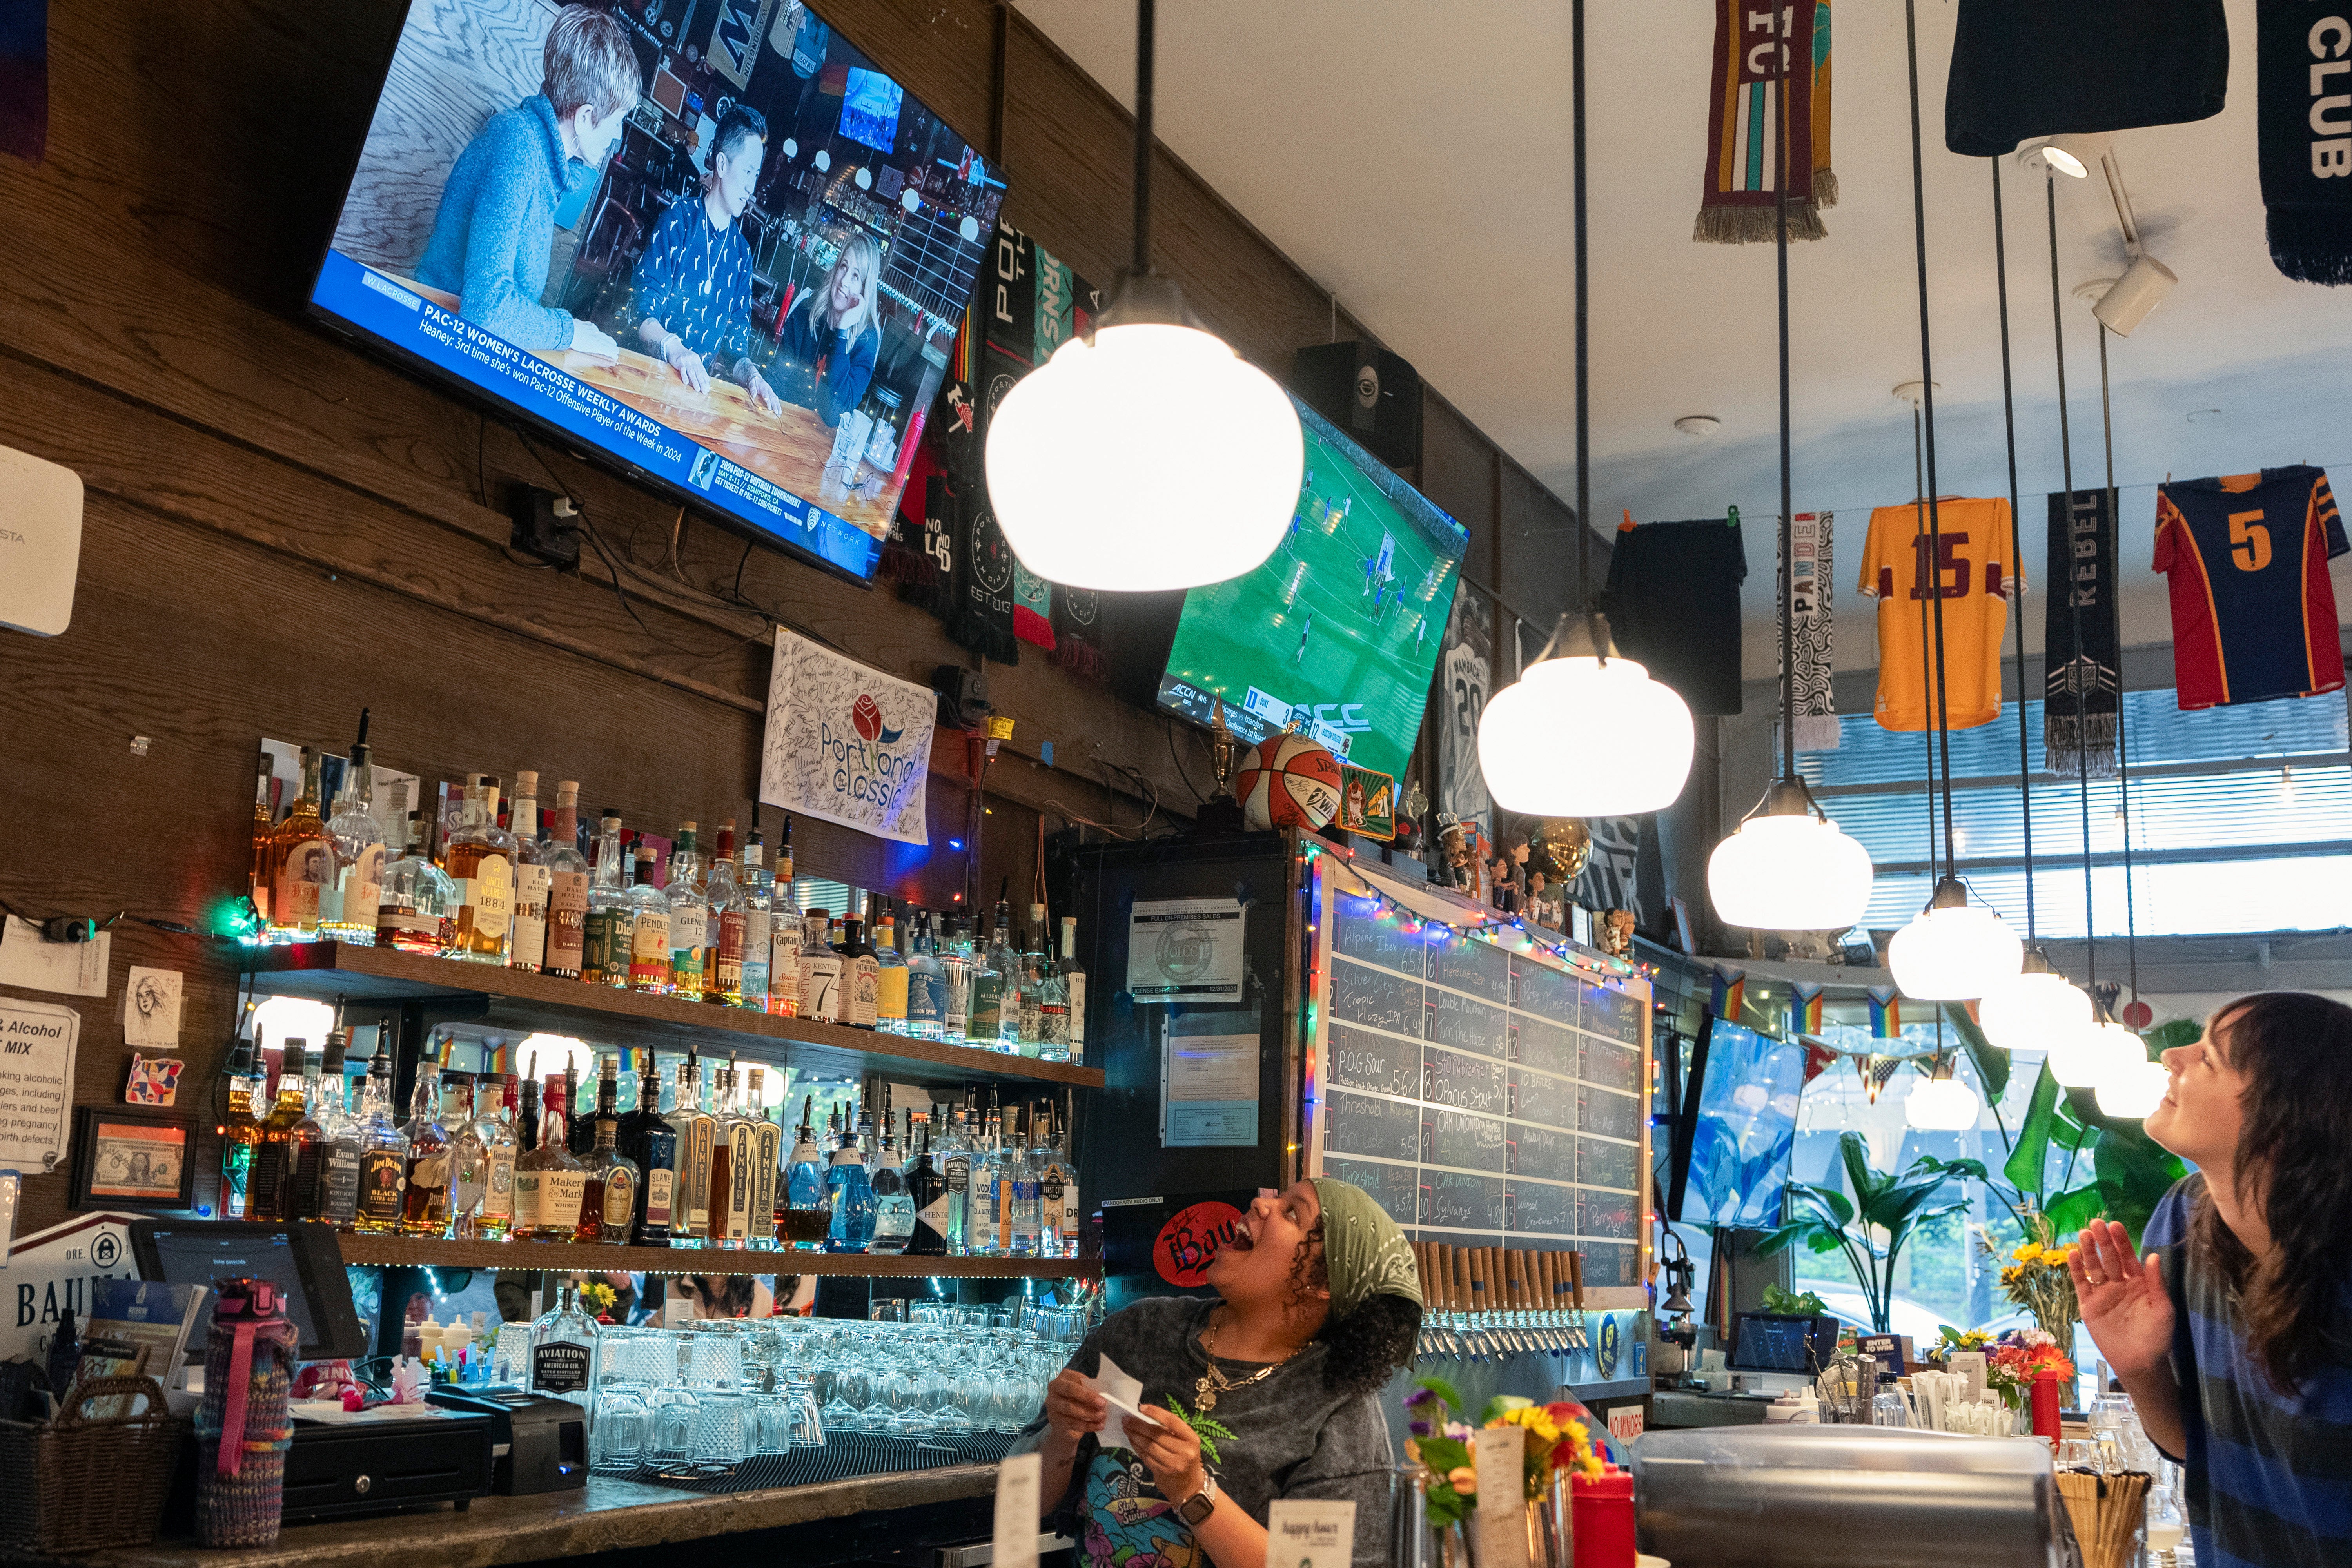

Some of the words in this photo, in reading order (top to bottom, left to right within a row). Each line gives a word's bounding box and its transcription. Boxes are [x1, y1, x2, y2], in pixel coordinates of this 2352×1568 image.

[744, 8, 768, 77] WASHINGTON
[2308, 16, 2352, 179] CLUB
[367, 276, 376, 285] W
[377, 281, 417, 307] LACROSSE
[424, 305, 465, 334] PAC-12
[467, 326, 519, 363] WOMEN'S
[521, 356, 576, 392] LACROSSE
[577, 384, 618, 414] WEEKLY
[618, 408, 661, 437] AWARDS
[419, 319, 454, 346] Heaney:
[455, 338, 471, 354] 3rd
[471, 347, 490, 364] time
[490, 357, 511, 375] she's
[512, 369, 529, 385] won
[530, 376, 555, 397] Pac-12
[556, 390, 590, 416] Offensive
[590, 407, 614, 428] Player
[614, 420, 624, 432] of
[623, 424, 635, 439] the
[636, 431, 656, 450] Week
[655, 441, 663, 454] in
[664, 446, 682, 463] 2024
[718, 469, 729, 480] MAY
[730, 475, 740, 486] 8-11
[747, 485, 771, 501] STANFORD,
[720, 460, 734, 474] 2024
[733, 466, 750, 482] PAC-12
[749, 474, 771, 493] SOFTBALL
[771, 485, 802, 508] TOURNAMENT
[715, 478, 724, 488] GET
[724, 481, 739, 495] TICKETS
[743, 491, 782, 516] PAC-12.COM/TICKETS
[821, 520, 860, 546] NETWORK
[2229, 509, 2271, 571] 5
[1910, 532, 1970, 600] 15
[1453, 657, 1479, 680] WAMBACH
[1172, 683, 1196, 699] ACCN
[1198, 694, 1207, 704] NHL
[1260, 697, 1269, 708] DUKE
[1283, 708, 1289, 725] 3
[1455, 679, 1481, 737] 20
[1226, 719, 1247, 735] Conference
[1254, 731, 1266, 742] Round
[1245, 715, 1264, 730] Islanders
[1312, 722, 1319, 739] 12
[1323, 729, 1332, 739] BOSTON
[1332, 733, 1342, 744] COLLEGE
[1378, 795, 1389, 817] 21
[481, 885, 507, 899] NEAREST
[486, 876, 504, 888] UNCLE
[480, 896, 505, 910] 1884
[695, 927, 702, 935] 12
[776, 935, 798, 946] Captain
[1170, 946, 1198, 957] OLCC
[1345, 926, 1374, 951] Alpine
[1376, 935, 1396, 951] Ibex
[1401, 947, 1423, 975] 6.5%
[813, 962, 839, 971] KENTUCKY
[1428, 952, 1434, 978] 6
[800, 962, 810, 1011] SPIRITLESS
[1342, 965, 1371, 993] Silver
[1373, 973, 1394, 999] City
[1510, 980, 1516, 1002] 11
[1343, 991, 1374, 1011] Tropic
[1438, 990, 1459, 1011] Double
[1387, 1010, 1400, 1024] IPA
[1426, 1012, 1433, 1038] 7
[8, 1020, 62, 1038] Alcohol
[1437, 1017, 1453, 1040] Turn
[1454, 1020, 1468, 1044] The
[1469, 1027, 1485, 1046] Haze
[5, 1041, 33, 1056] MIX
[1509, 1037, 1517, 1059] 12
[1365, 1052, 1385, 1076] Sour
[24, 1073, 62, 1085] alcoholic
[1392, 1070, 1417, 1096] 5.6%
[1425, 1070, 1432, 1098] 8
[1521, 1074, 1529, 1087] 10
[1531, 1074, 1554, 1090] BARREL
[21, 1088, 61, 1101] including
[1469, 1087, 1492, 1106] Stout
[1493, 1076, 1504, 1100] 5%
[21, 1103, 37, 1112] and
[40, 1104, 59, 1114] beer
[1340, 1093, 1382, 1118] Threshold
[1507, 1095, 1516, 1115] 13
[11, 1118, 57, 1131] pregnancy
[1437, 1111, 1453, 1136] OAK
[1456, 1114, 1475, 1133] UNION
[22, 1134, 55, 1145] defects.
[1423, 1132, 1429, 1160] 9
[328, 1158, 359, 1169] Williams
[336, 1149, 354, 1159] Evan
[698, 1130, 706, 1197] AIMSIR
[372, 1158, 383, 1173] JIM
[385, 1158, 401, 1174] BEAM
[1339, 1163, 1379, 1189] Threshold
[550, 1177, 584, 1188] Maker's
[652, 1173, 671, 1183] SLANE
[1436, 1172, 1453, 1189] OAK
[1456, 1175, 1482, 1188] UNION
[559, 1189, 582, 1199] Mark
[1395, 1192, 1413, 1216] 6.5%
[1419, 1198, 1429, 1218] 10
[66, 1249, 87, 1261] ORE.
[1867, 1337, 1891, 1345] ENTER
[538, 1349, 586, 1360] AVIATION
[1610, 1417, 1619, 1439] NO
[1621, 1413, 1642, 1438] MINORS
[1118, 1501, 1136, 1514] Sink
[1123, 1511, 1148, 1524] Swim
